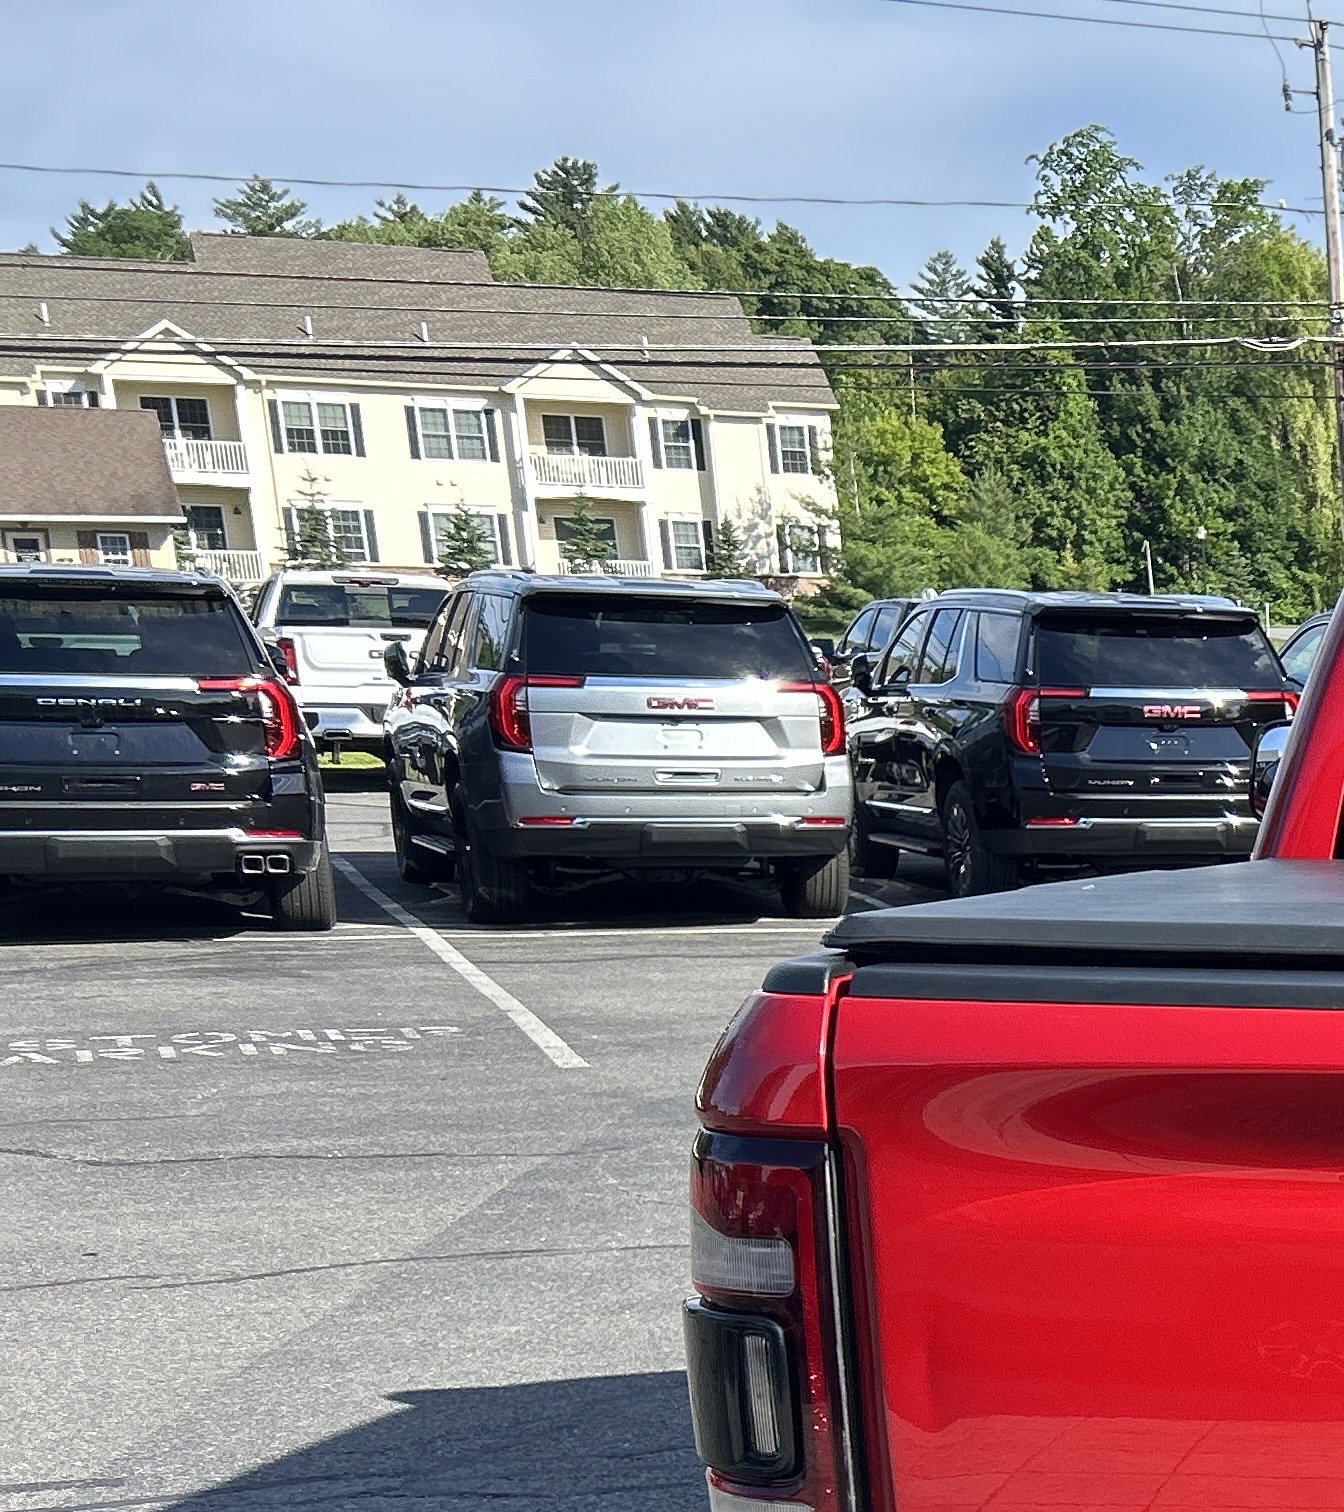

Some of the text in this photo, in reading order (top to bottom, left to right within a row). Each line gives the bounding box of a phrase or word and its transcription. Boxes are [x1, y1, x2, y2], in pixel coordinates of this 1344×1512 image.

[36, 698, 142, 706] DENALI
[646, 696, 715, 710] GMC
[1143, 705, 1201, 719] GMC
